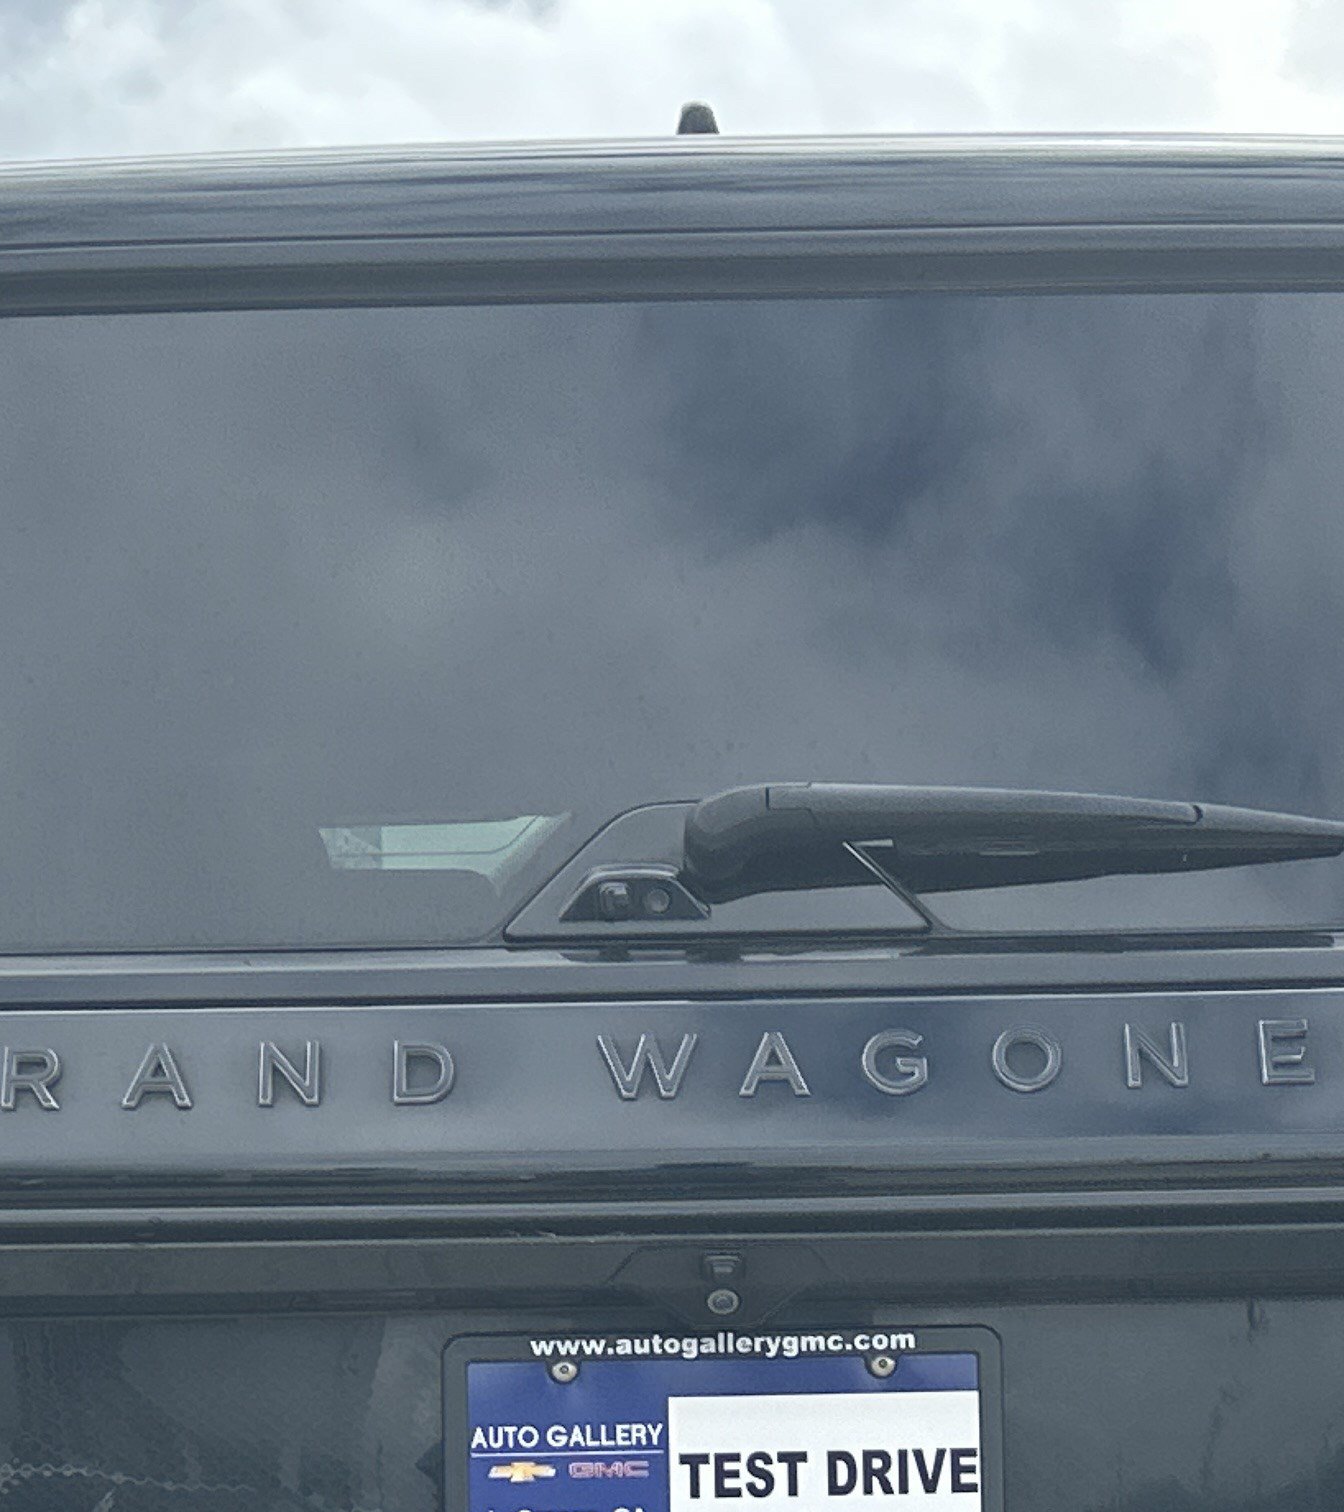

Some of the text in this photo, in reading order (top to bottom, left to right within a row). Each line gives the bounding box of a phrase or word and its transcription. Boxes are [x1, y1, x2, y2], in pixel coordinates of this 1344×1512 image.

[530, 1331, 916, 1357] www.autogallerygmc.com
[471, 1423, 663, 1449] AUTO GALLERY
[569, 1460, 650, 1479] GMC
[680, 1447, 979, 1499] TEST DRIVE
